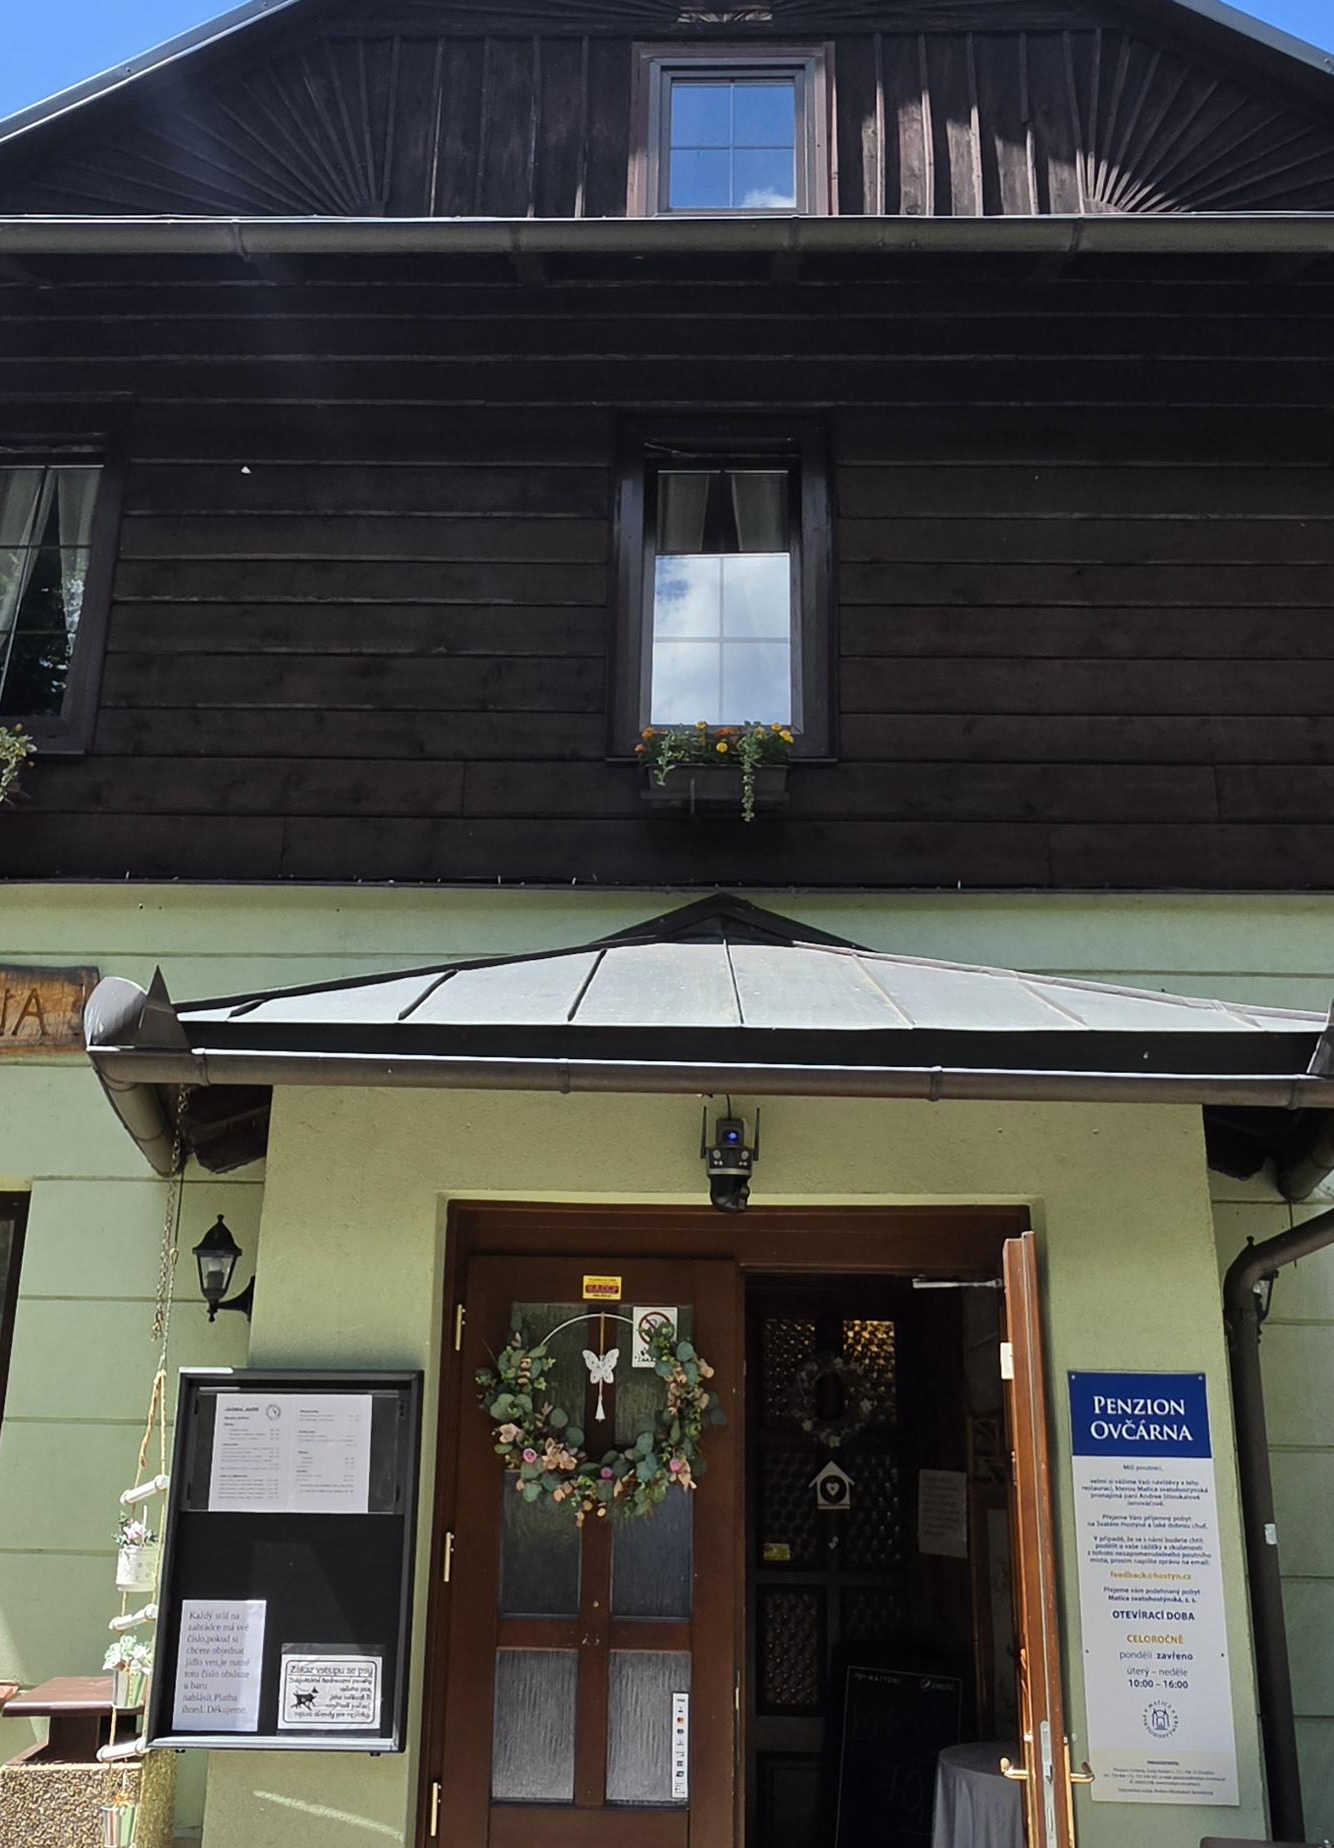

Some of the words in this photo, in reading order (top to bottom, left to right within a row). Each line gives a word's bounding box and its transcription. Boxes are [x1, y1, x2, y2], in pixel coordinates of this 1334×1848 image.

[1093, 1395, 1185, 1416] PENZION
[1090, 1419, 1194, 1441] OVČÁRNA
[1112, 1609, 1164, 1620] OTEVÍRACÍ
[1167, 1611, 1195, 1621] DOBA
[1119, 1650, 1153, 1660] pondělí
[1156, 1651, 1194, 1661] zavřeno
[316, 1665, 345, 1677] vstupu
[1127, 1666, 1149, 1677] úterý
[1158, 1667, 1188, 1677] neděle
[1129, 1679, 1154, 1688] 10:00
[1163, 1680, 1189, 1689] 16:00
